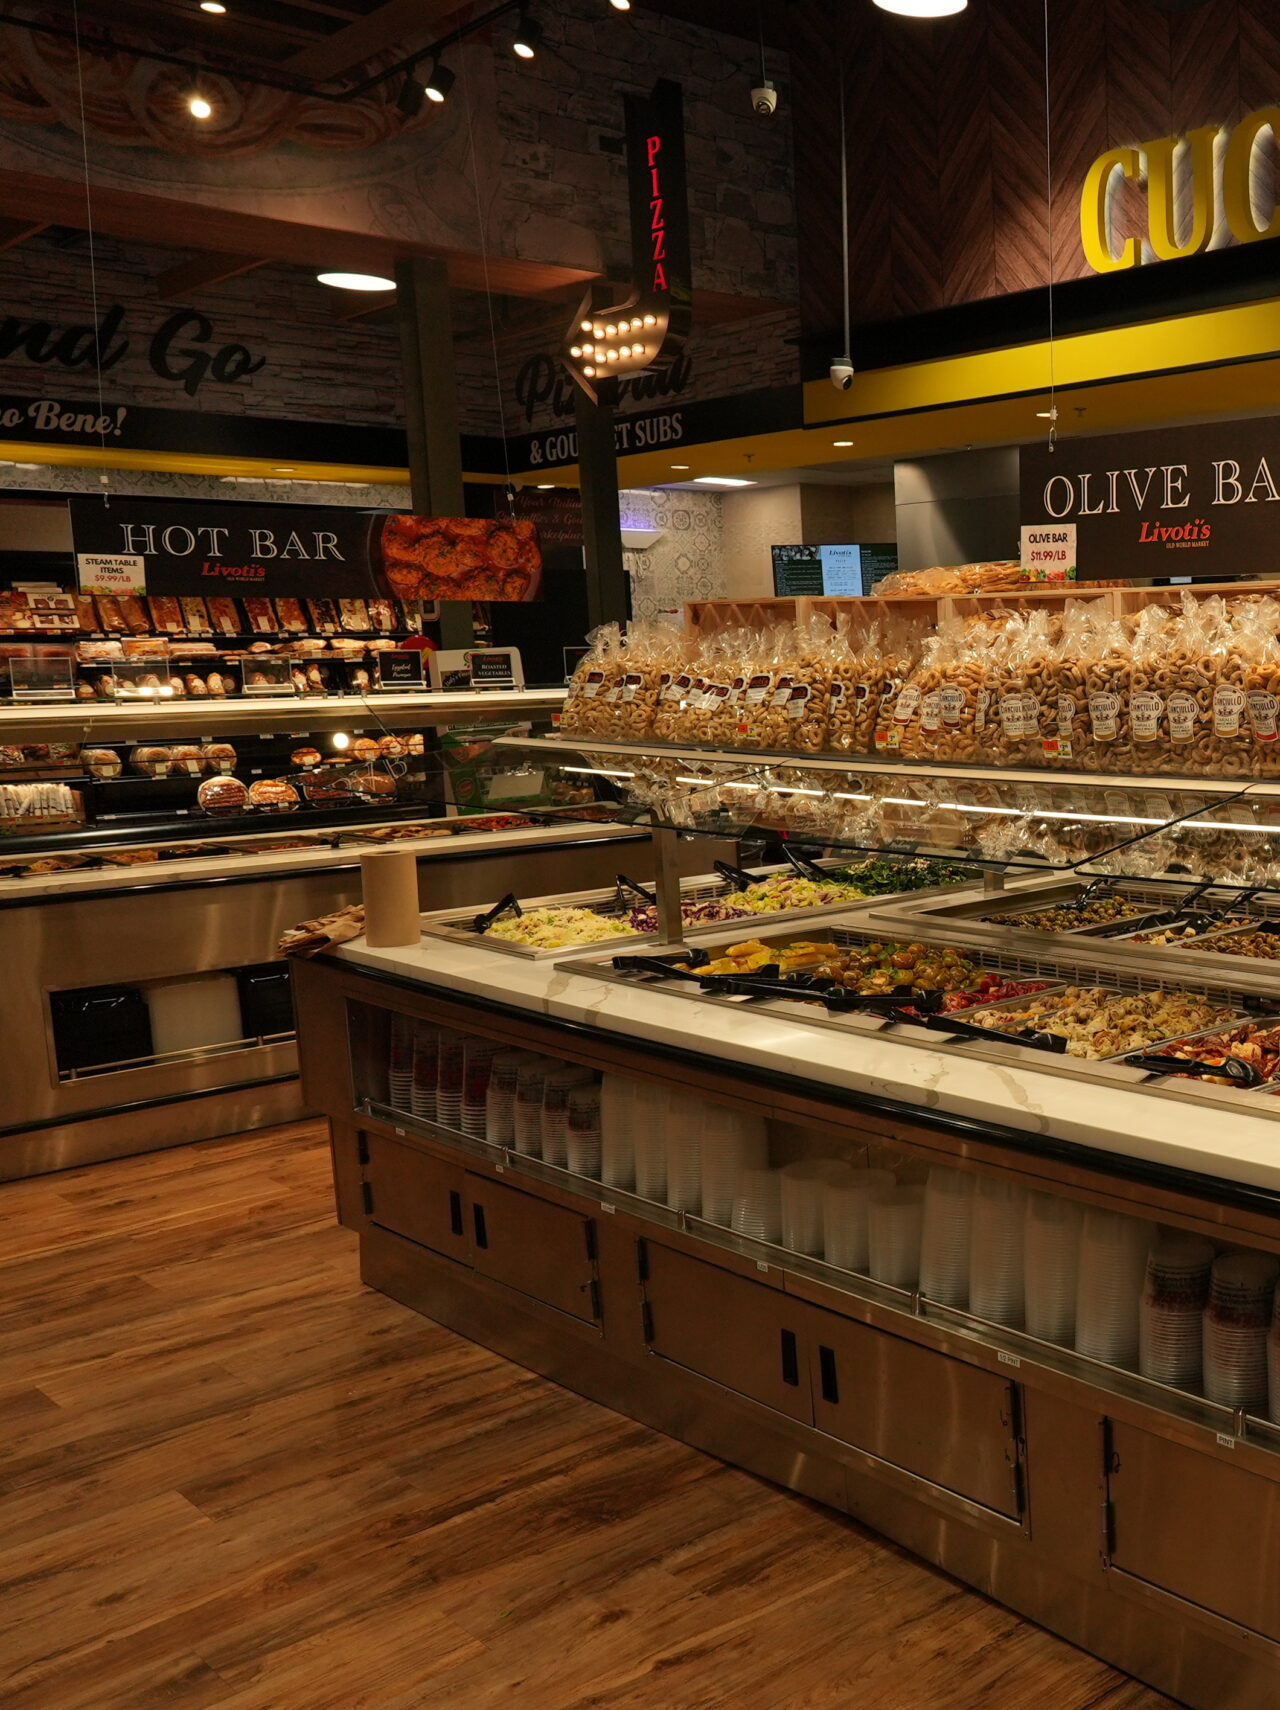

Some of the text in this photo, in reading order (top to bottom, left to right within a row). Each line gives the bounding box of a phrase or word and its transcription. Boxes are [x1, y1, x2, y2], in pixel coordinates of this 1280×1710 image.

[645, 136, 668, 293] PIZZA
[150, 311, 266, 396] Go
[0, 400, 127, 437] o Bene!
[529, 412, 683, 465] & GOUT SUBS
[1043, 464, 1191, 518] OLIVE
[1028, 532, 1068, 544] OLIVE BAR
[1139, 518, 1211, 543] Livoti's
[119, 523, 346, 561] HOT BAR
[85, 558, 112, 566] STEAM
[1030, 549, 1066, 562] $11.99/LB
[94, 574, 131, 582] $9.99/LB
[100, 566, 124, 574] ITEMS
[201, 562, 265, 577] Livoti's
[1218, 1436, 1233, 1446] PINT
